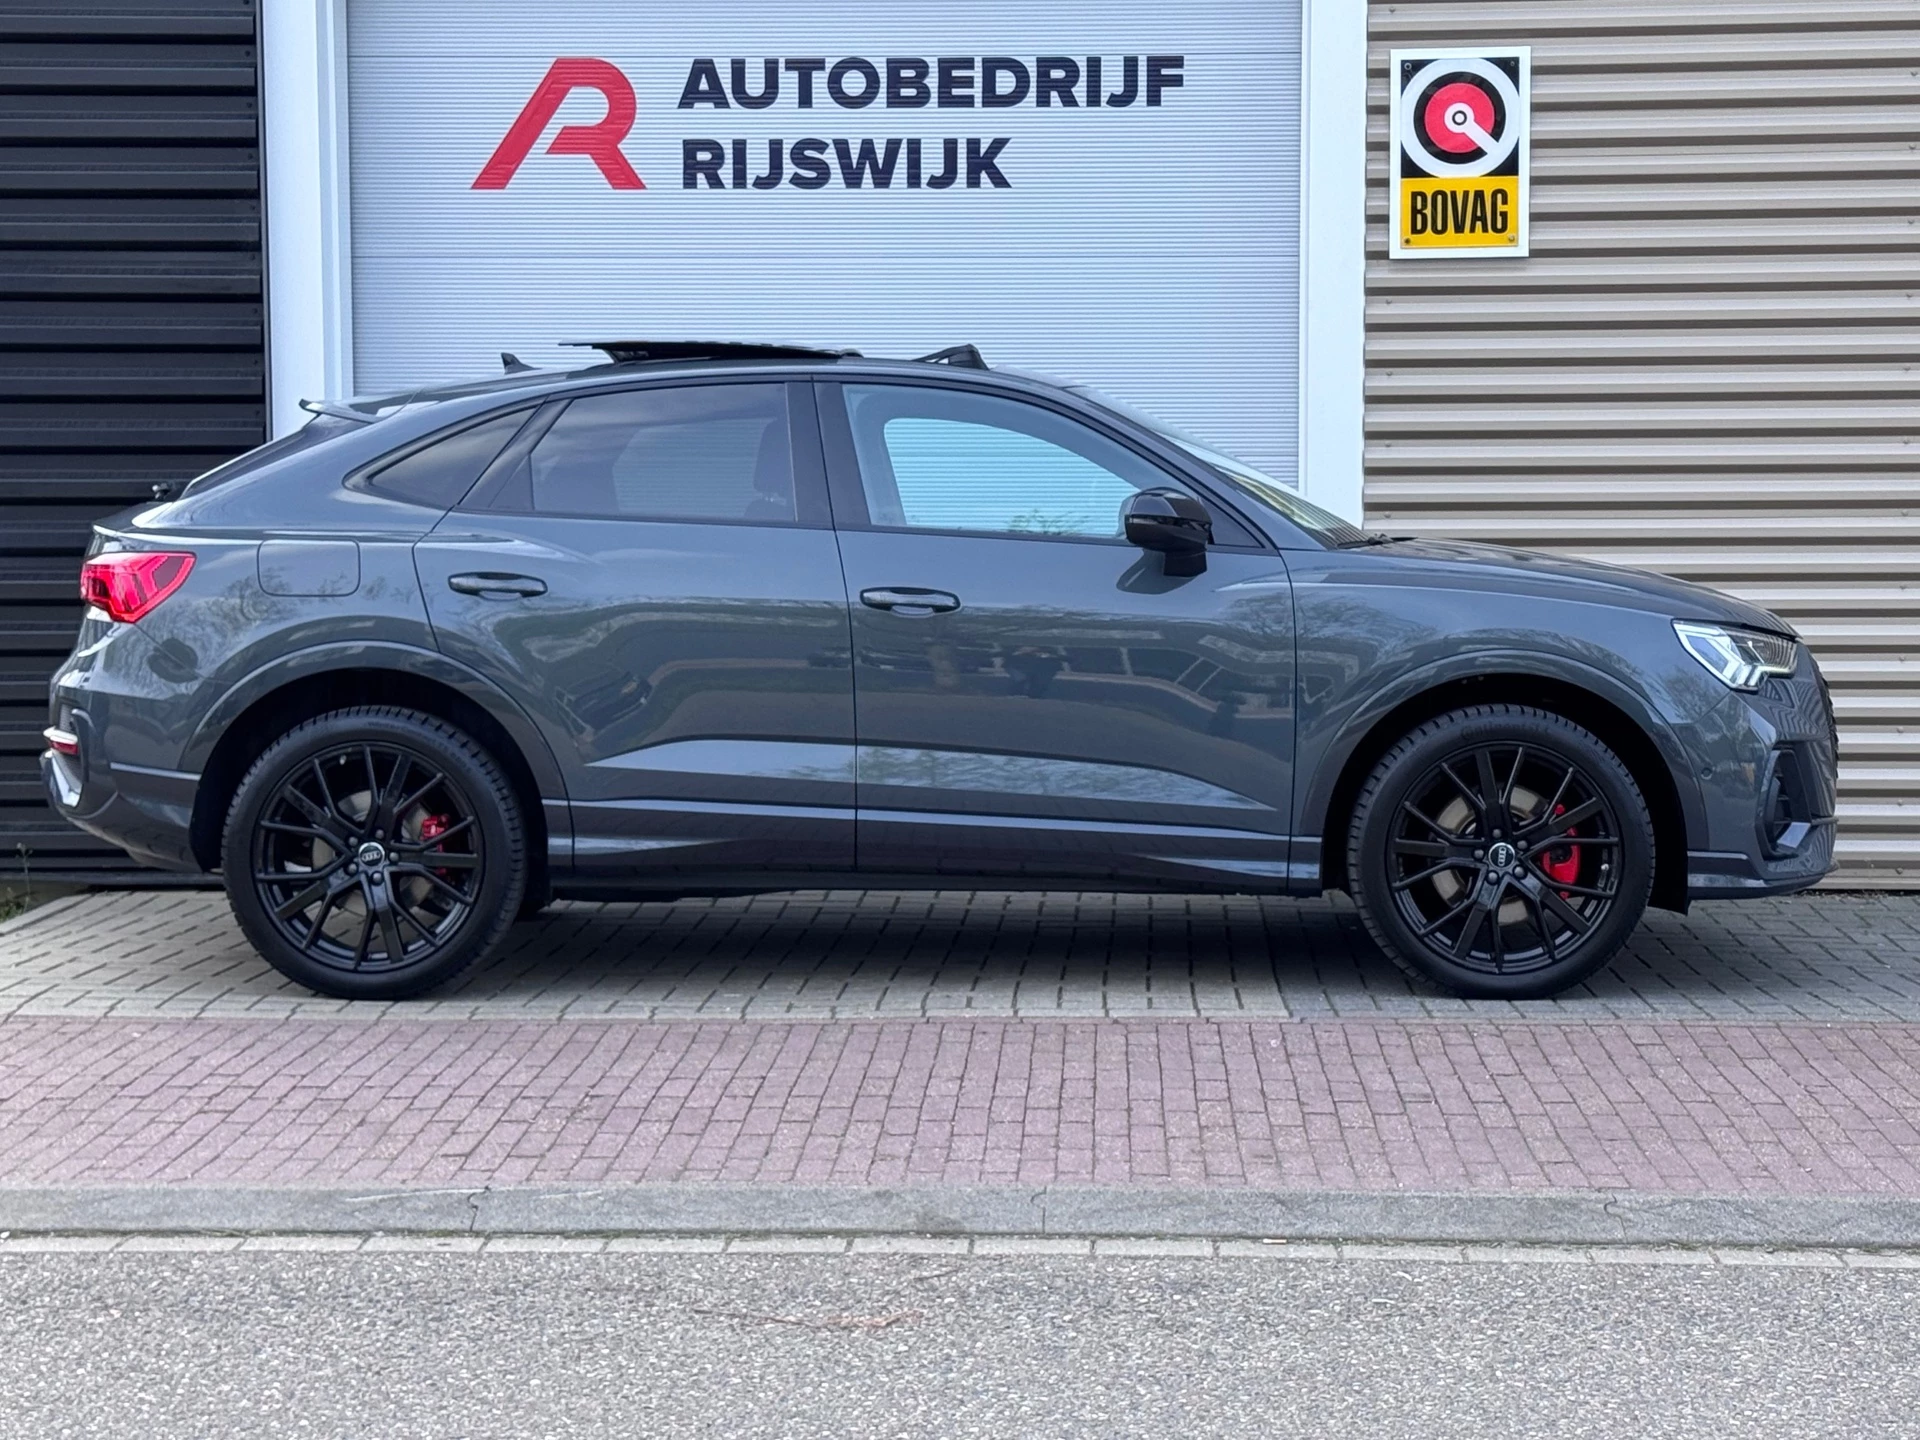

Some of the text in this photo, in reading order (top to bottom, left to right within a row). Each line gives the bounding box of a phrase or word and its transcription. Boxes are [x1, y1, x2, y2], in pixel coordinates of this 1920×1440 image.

[678, 55, 1185, 110] AUTOBEDRIJF
[682, 138, 1013, 190] RIJSWIJK
[1410, 188, 1509, 235] BOVAG
